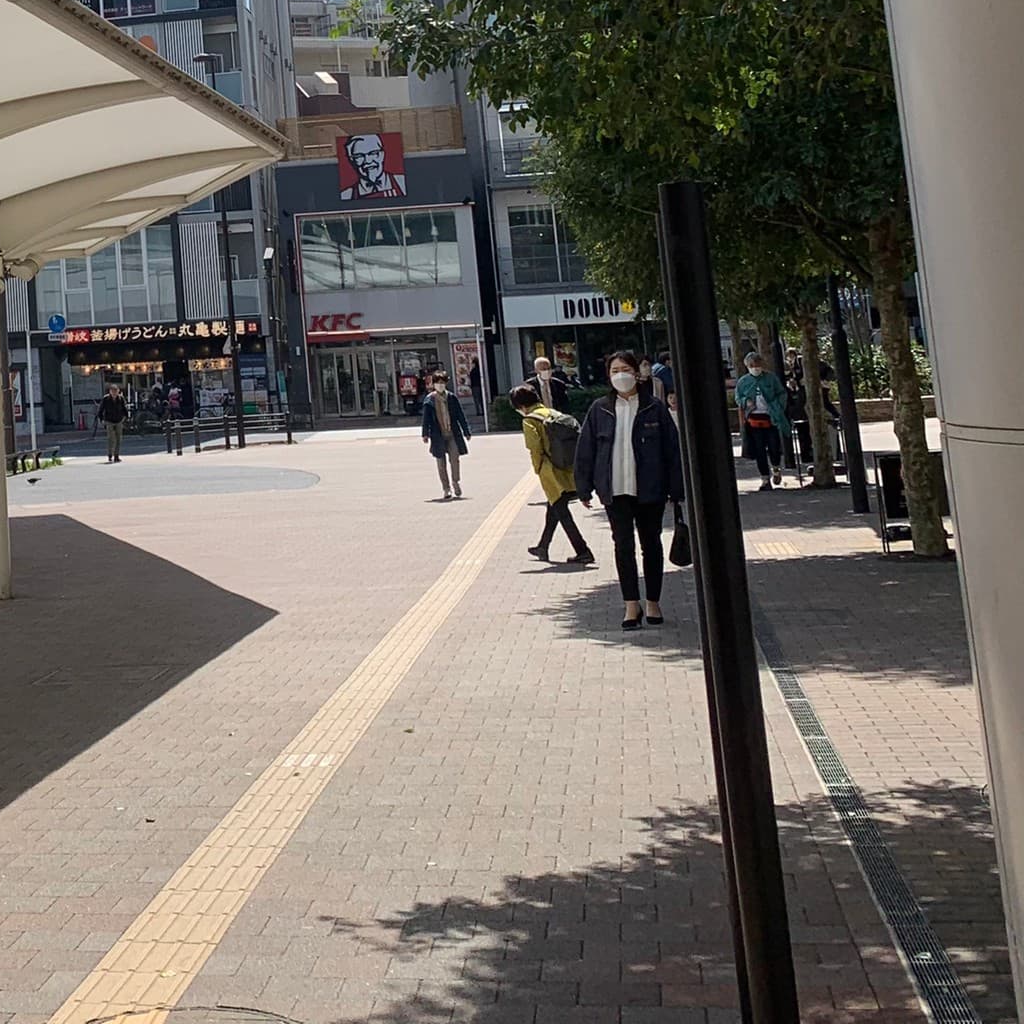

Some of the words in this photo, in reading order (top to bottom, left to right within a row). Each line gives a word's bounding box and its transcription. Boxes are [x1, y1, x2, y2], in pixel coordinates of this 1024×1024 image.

[308, 312, 364, 332] KFC
[90, 325, 168, 342] 釜揚げうどん
